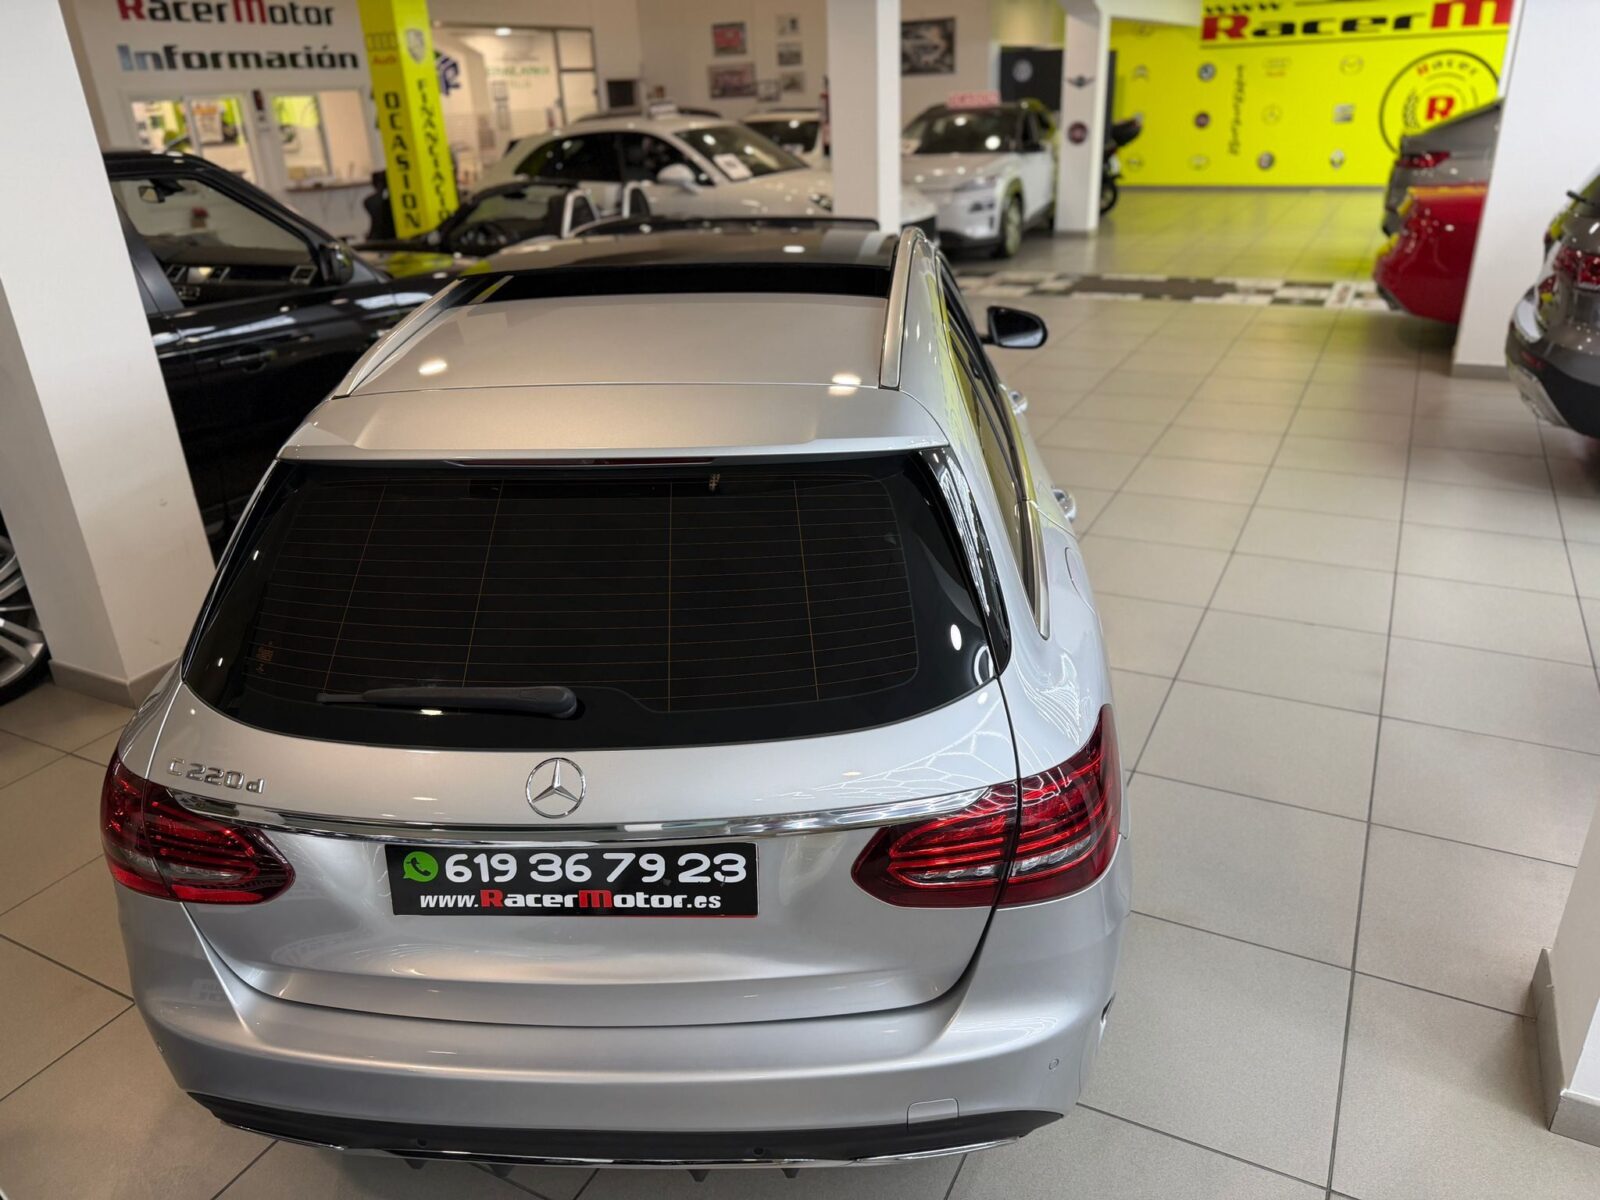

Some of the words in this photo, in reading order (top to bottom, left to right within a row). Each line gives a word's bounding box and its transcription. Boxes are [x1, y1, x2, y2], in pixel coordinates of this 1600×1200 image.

[116, 0, 335, 25] RacerMotor
[117, 44, 359, 71] Información
[1425, 96, 1455, 121] R
[384, 91, 421, 228] OCASION
[445, 853, 517, 883] 619
[529, 853, 592, 883] 36
[603, 853, 666, 883] 79
[677, 853, 747, 883] 23
[420, 889, 721, 909] www.RacerMotor.es
